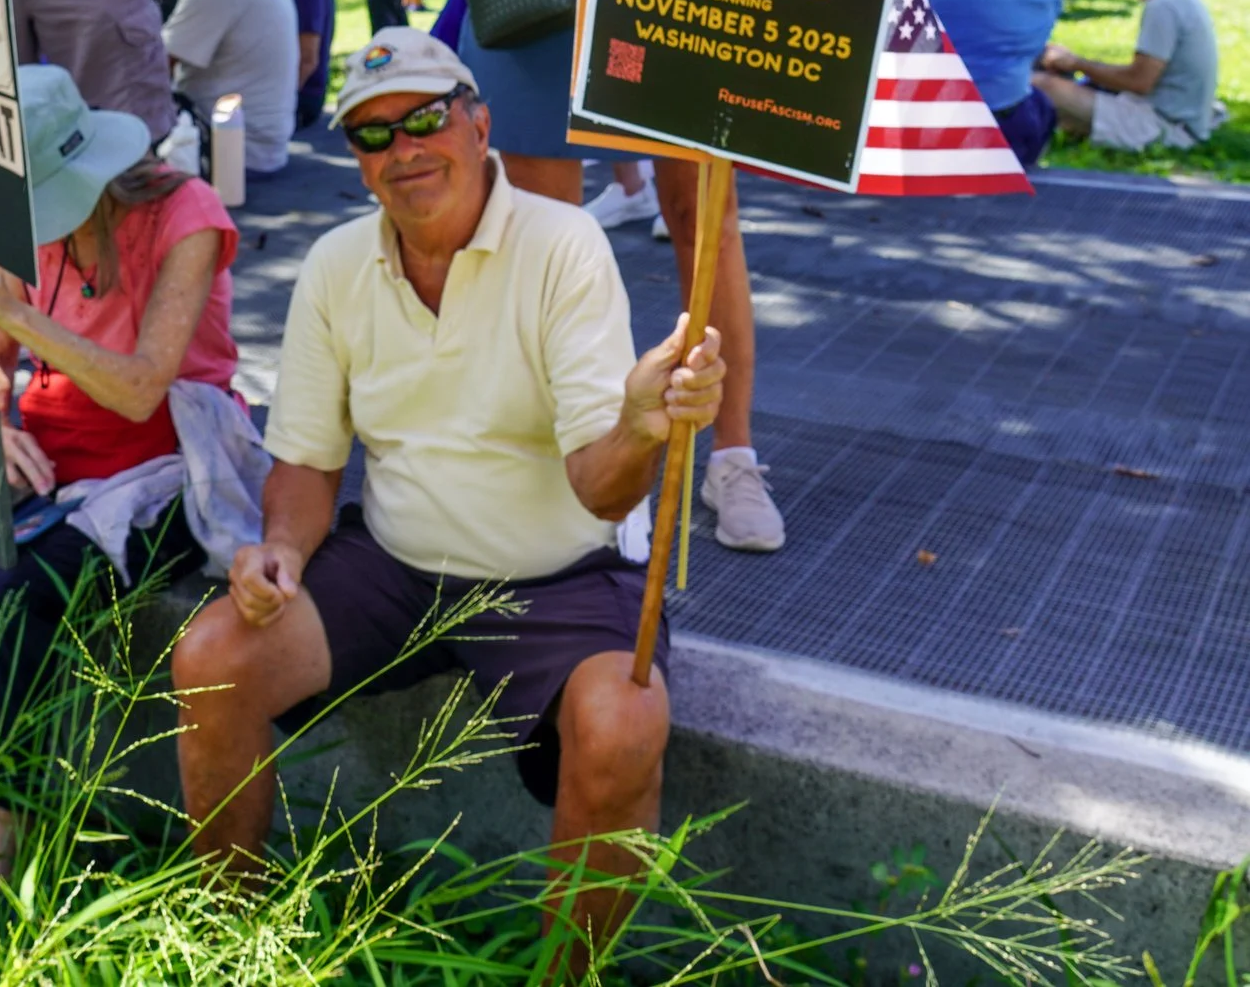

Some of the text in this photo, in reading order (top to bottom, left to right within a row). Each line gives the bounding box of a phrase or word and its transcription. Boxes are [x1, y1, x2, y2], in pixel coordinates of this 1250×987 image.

[635, 20, 822, 81] WASHINGTON DC
[763, 20, 779, 42] 5
[787, 26, 852, 59] 2025
